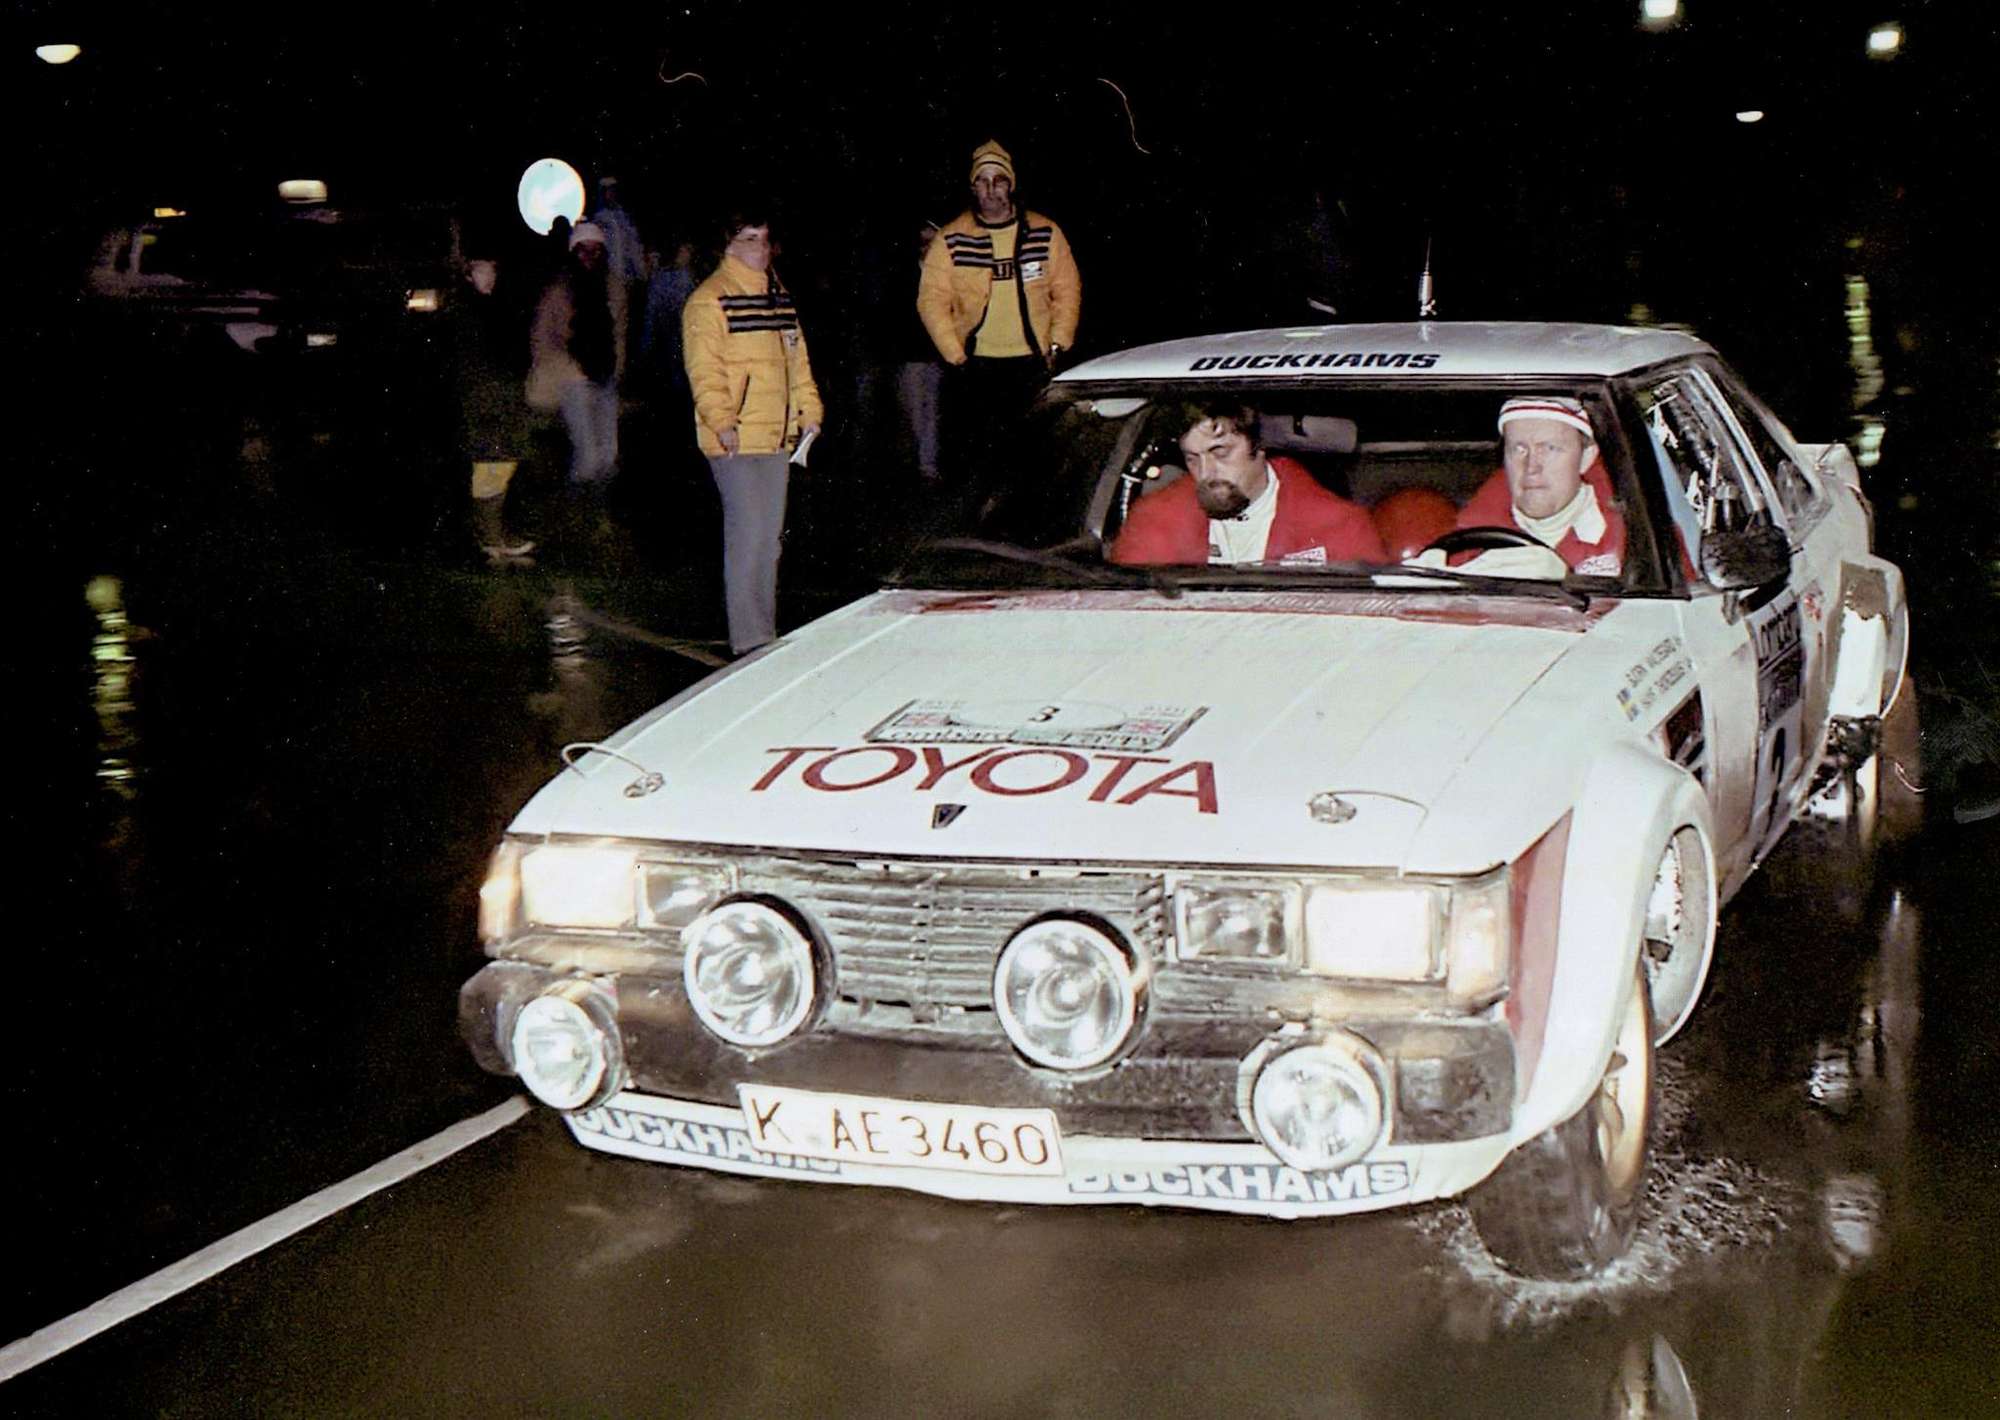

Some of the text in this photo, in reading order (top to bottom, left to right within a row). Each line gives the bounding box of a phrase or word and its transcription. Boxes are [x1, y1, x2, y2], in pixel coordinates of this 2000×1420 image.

[1189, 353, 1440, 371] DUCKHAMS
[1029, 706, 1060, 723] 3
[751, 746, 1219, 814] TOYOTA
[751, 1098, 792, 1144] K
[1068, 1160, 1411, 1203] DUCKHAMS
